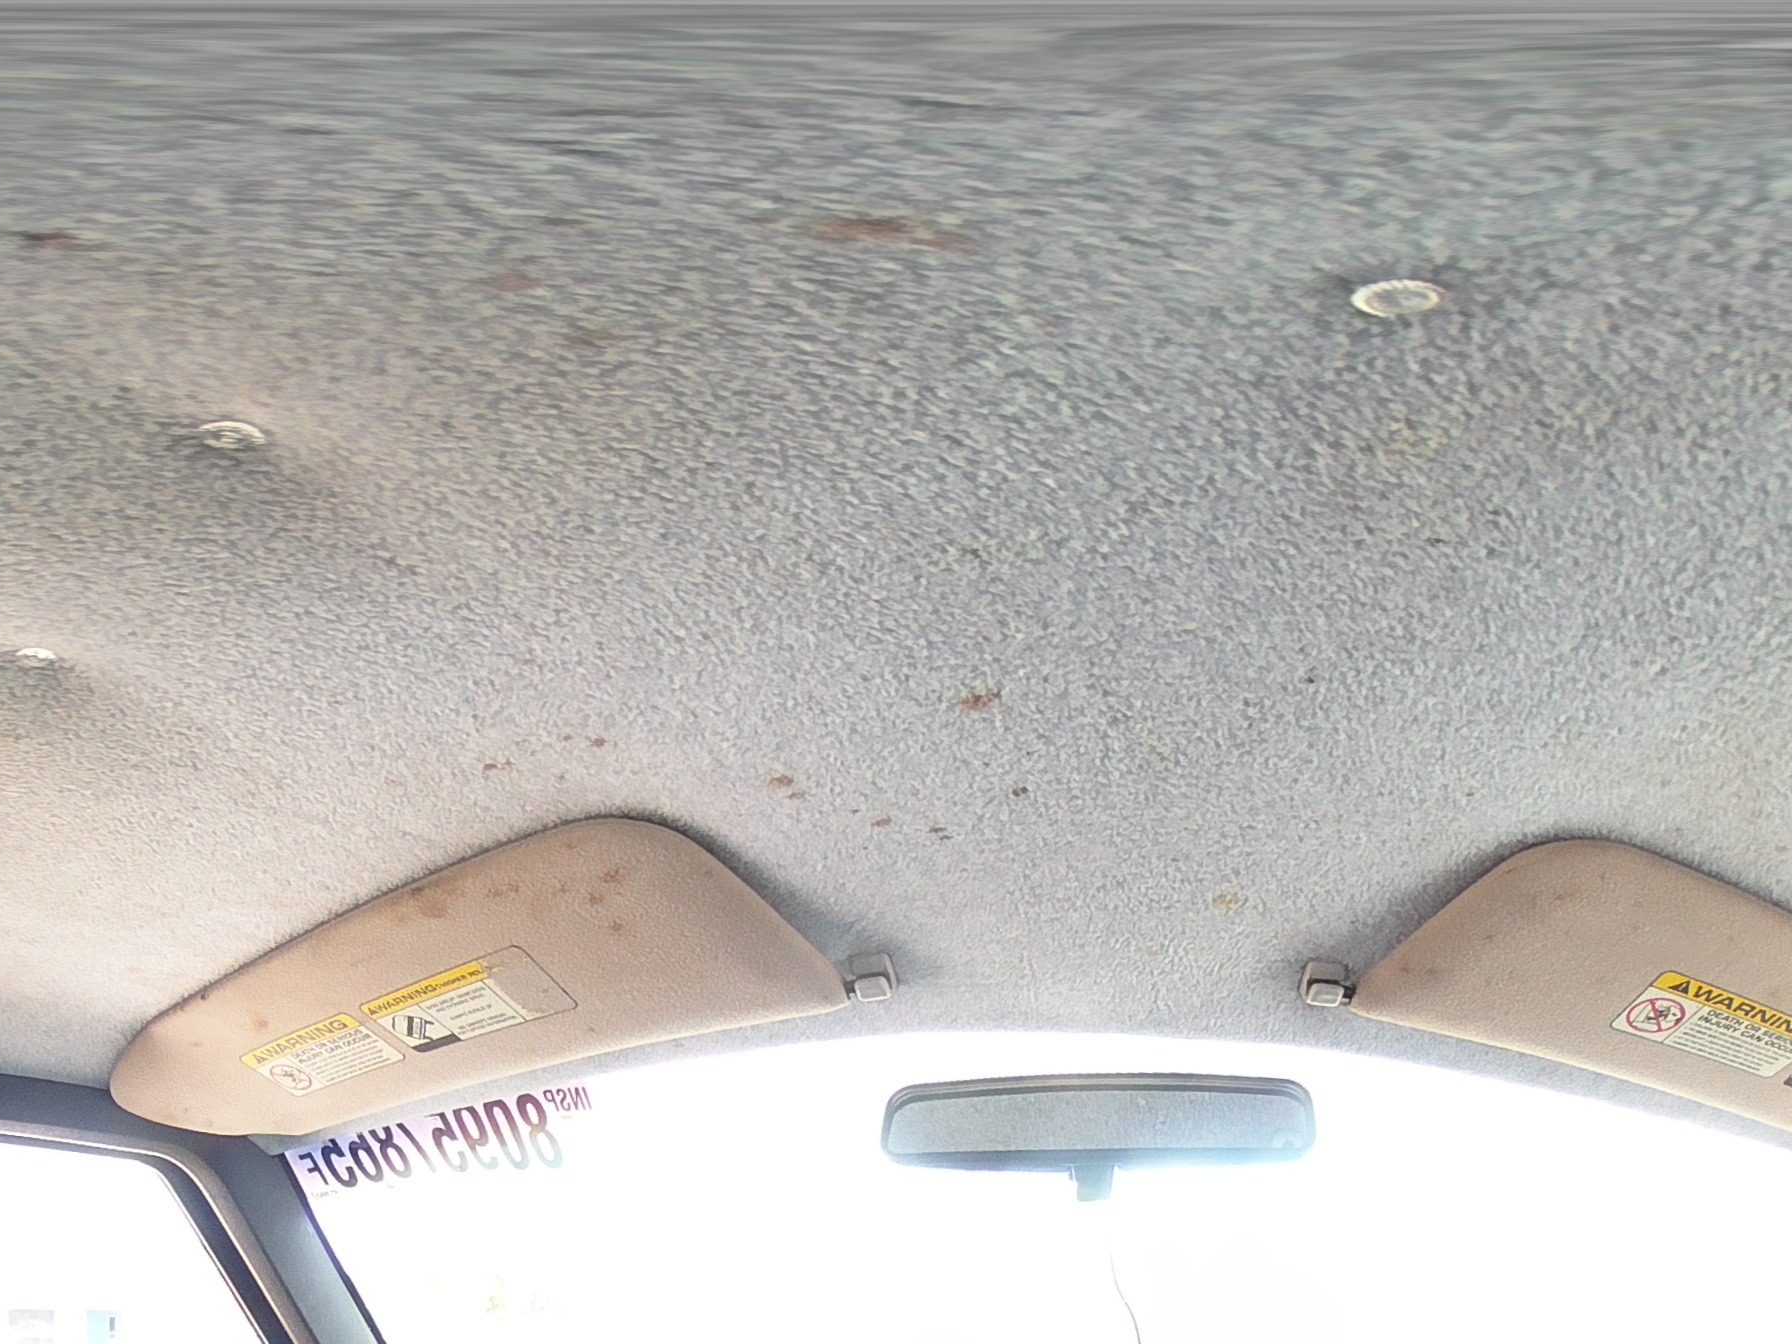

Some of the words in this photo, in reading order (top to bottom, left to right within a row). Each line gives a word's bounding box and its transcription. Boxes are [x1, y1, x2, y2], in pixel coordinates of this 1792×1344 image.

[1698, 1014, 1739, 1034] INJURY
[1740, 1030, 1761, 1043] CAN
[1707, 1009, 1743, 1026] DEATH
[1745, 1022, 1760, 1032] OR
[264, 1018, 348, 1059] WARNING
